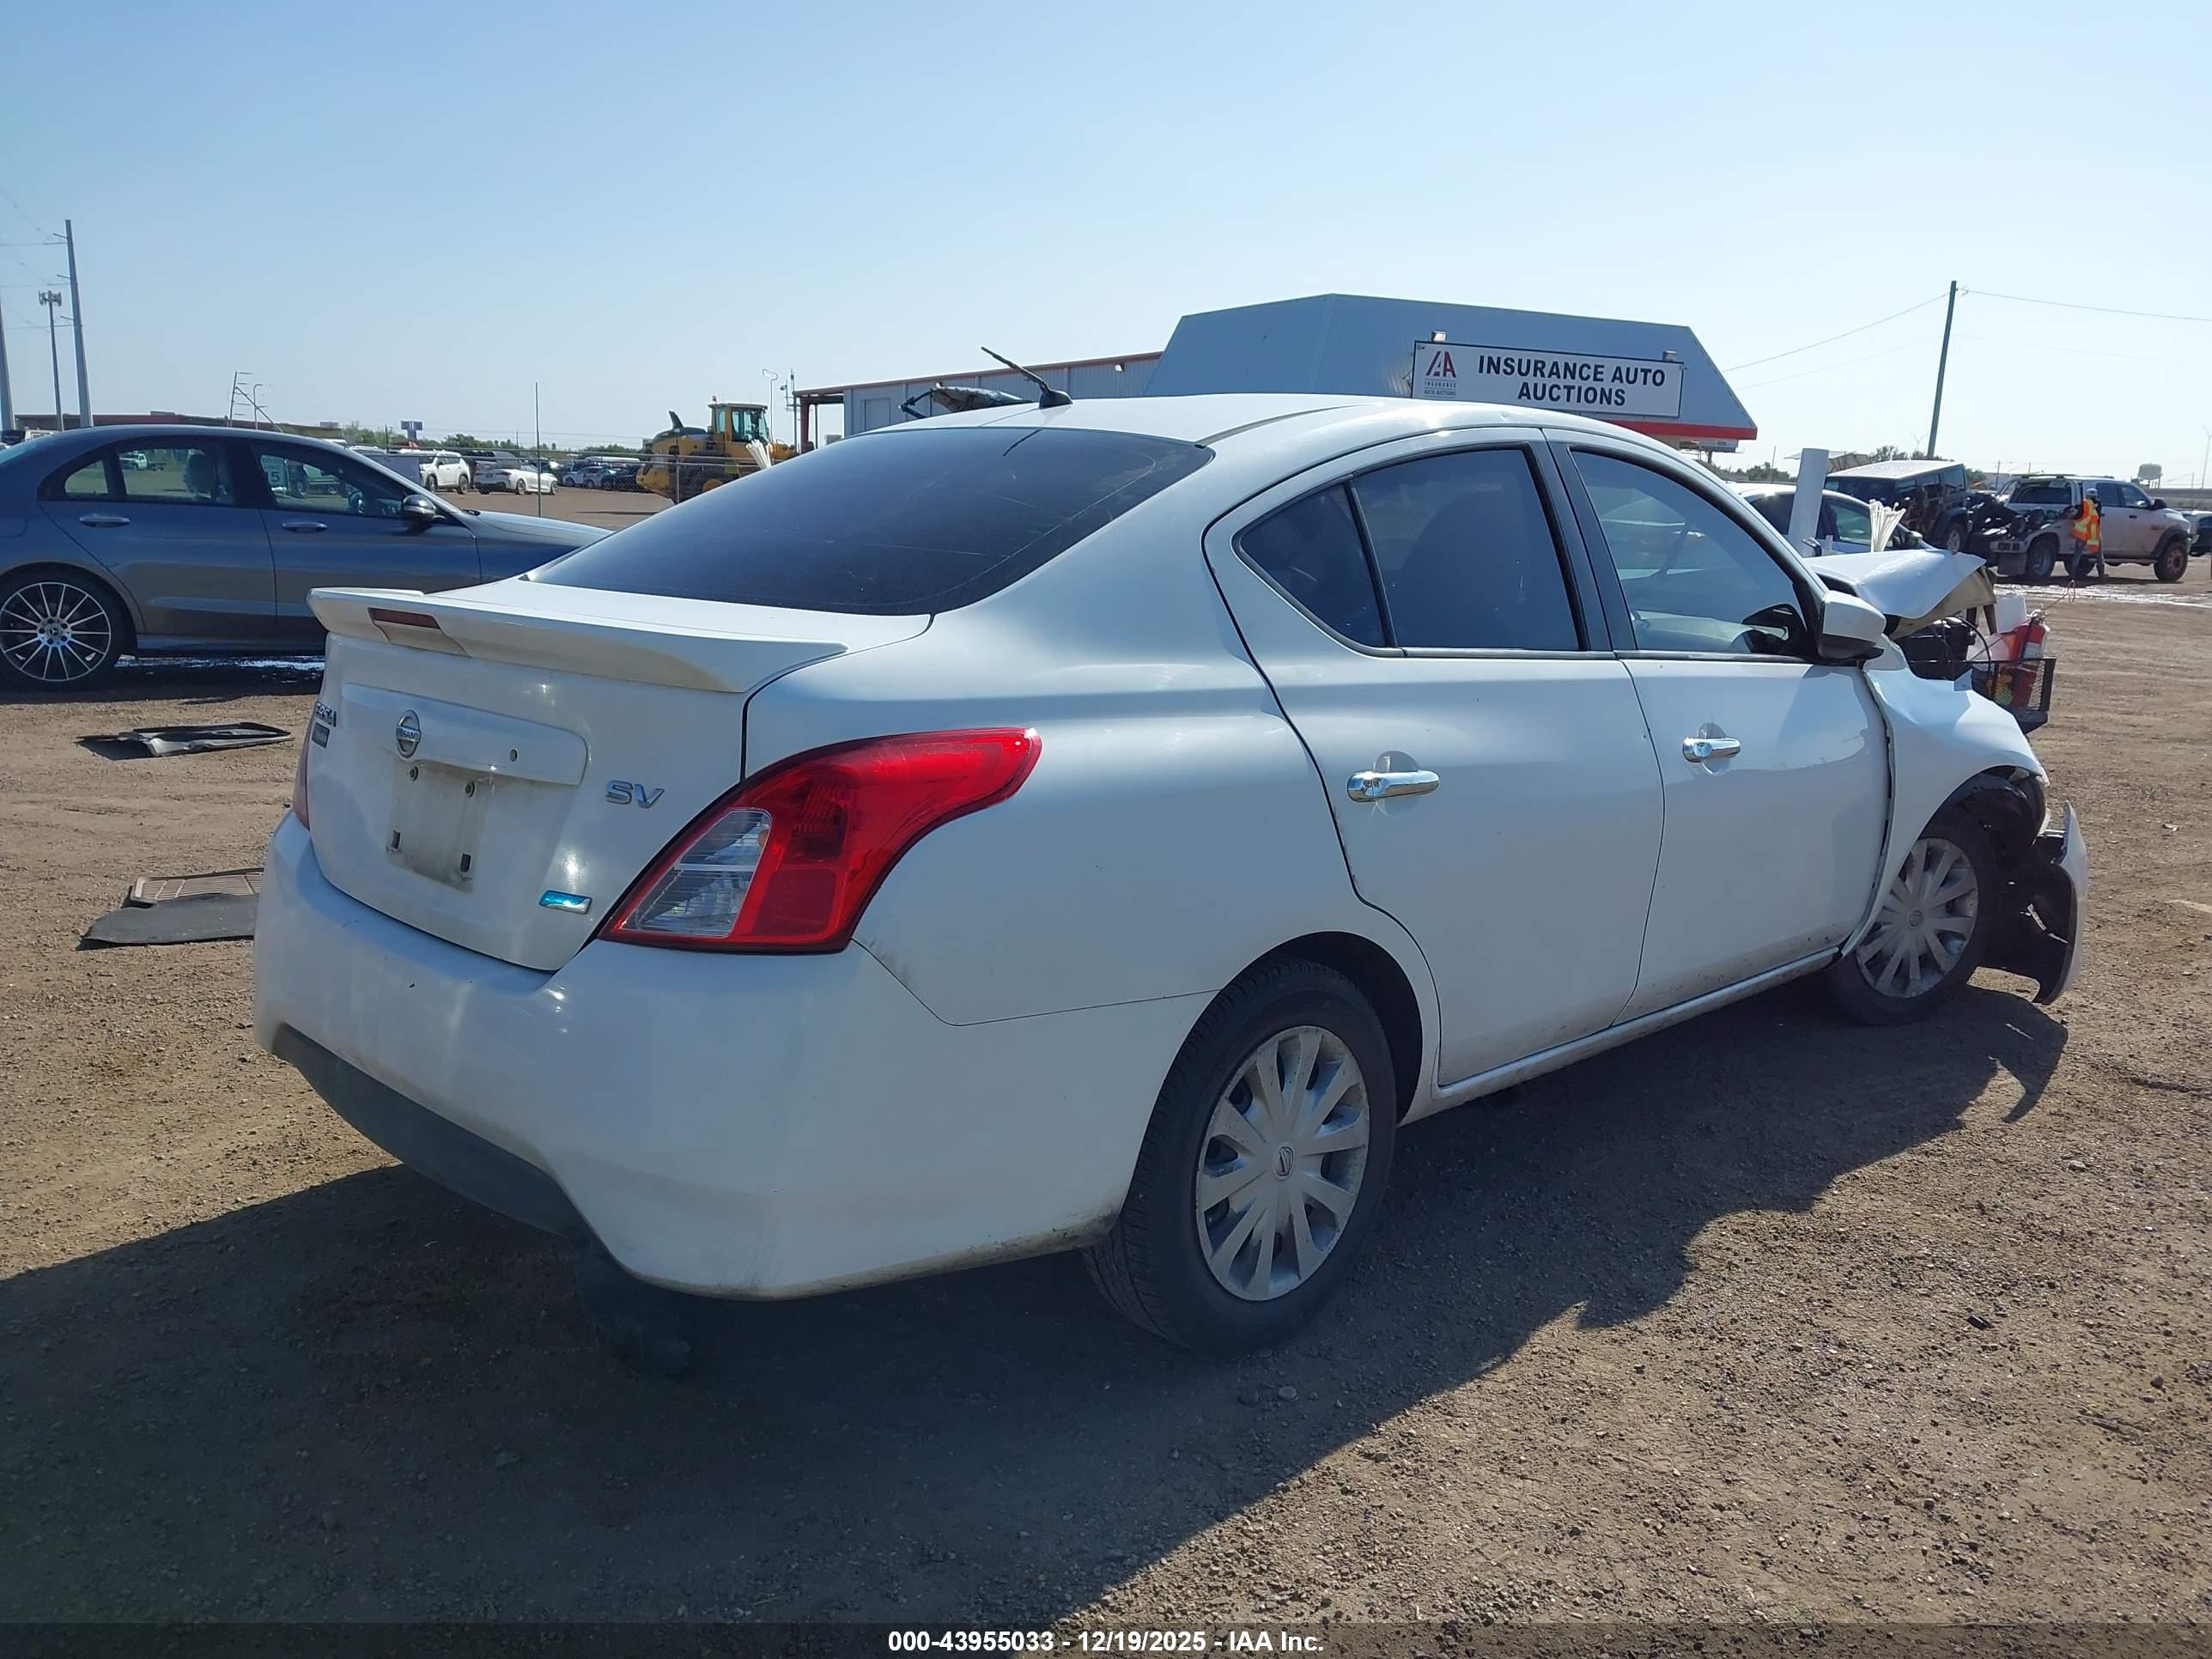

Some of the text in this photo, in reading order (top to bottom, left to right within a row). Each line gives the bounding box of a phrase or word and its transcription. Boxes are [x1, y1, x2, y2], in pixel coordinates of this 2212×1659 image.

[1478, 355, 1665, 386] INSURANCE AUTO
[1517, 382, 1626, 406] AUCTIONS
[604, 780, 665, 809] SV
